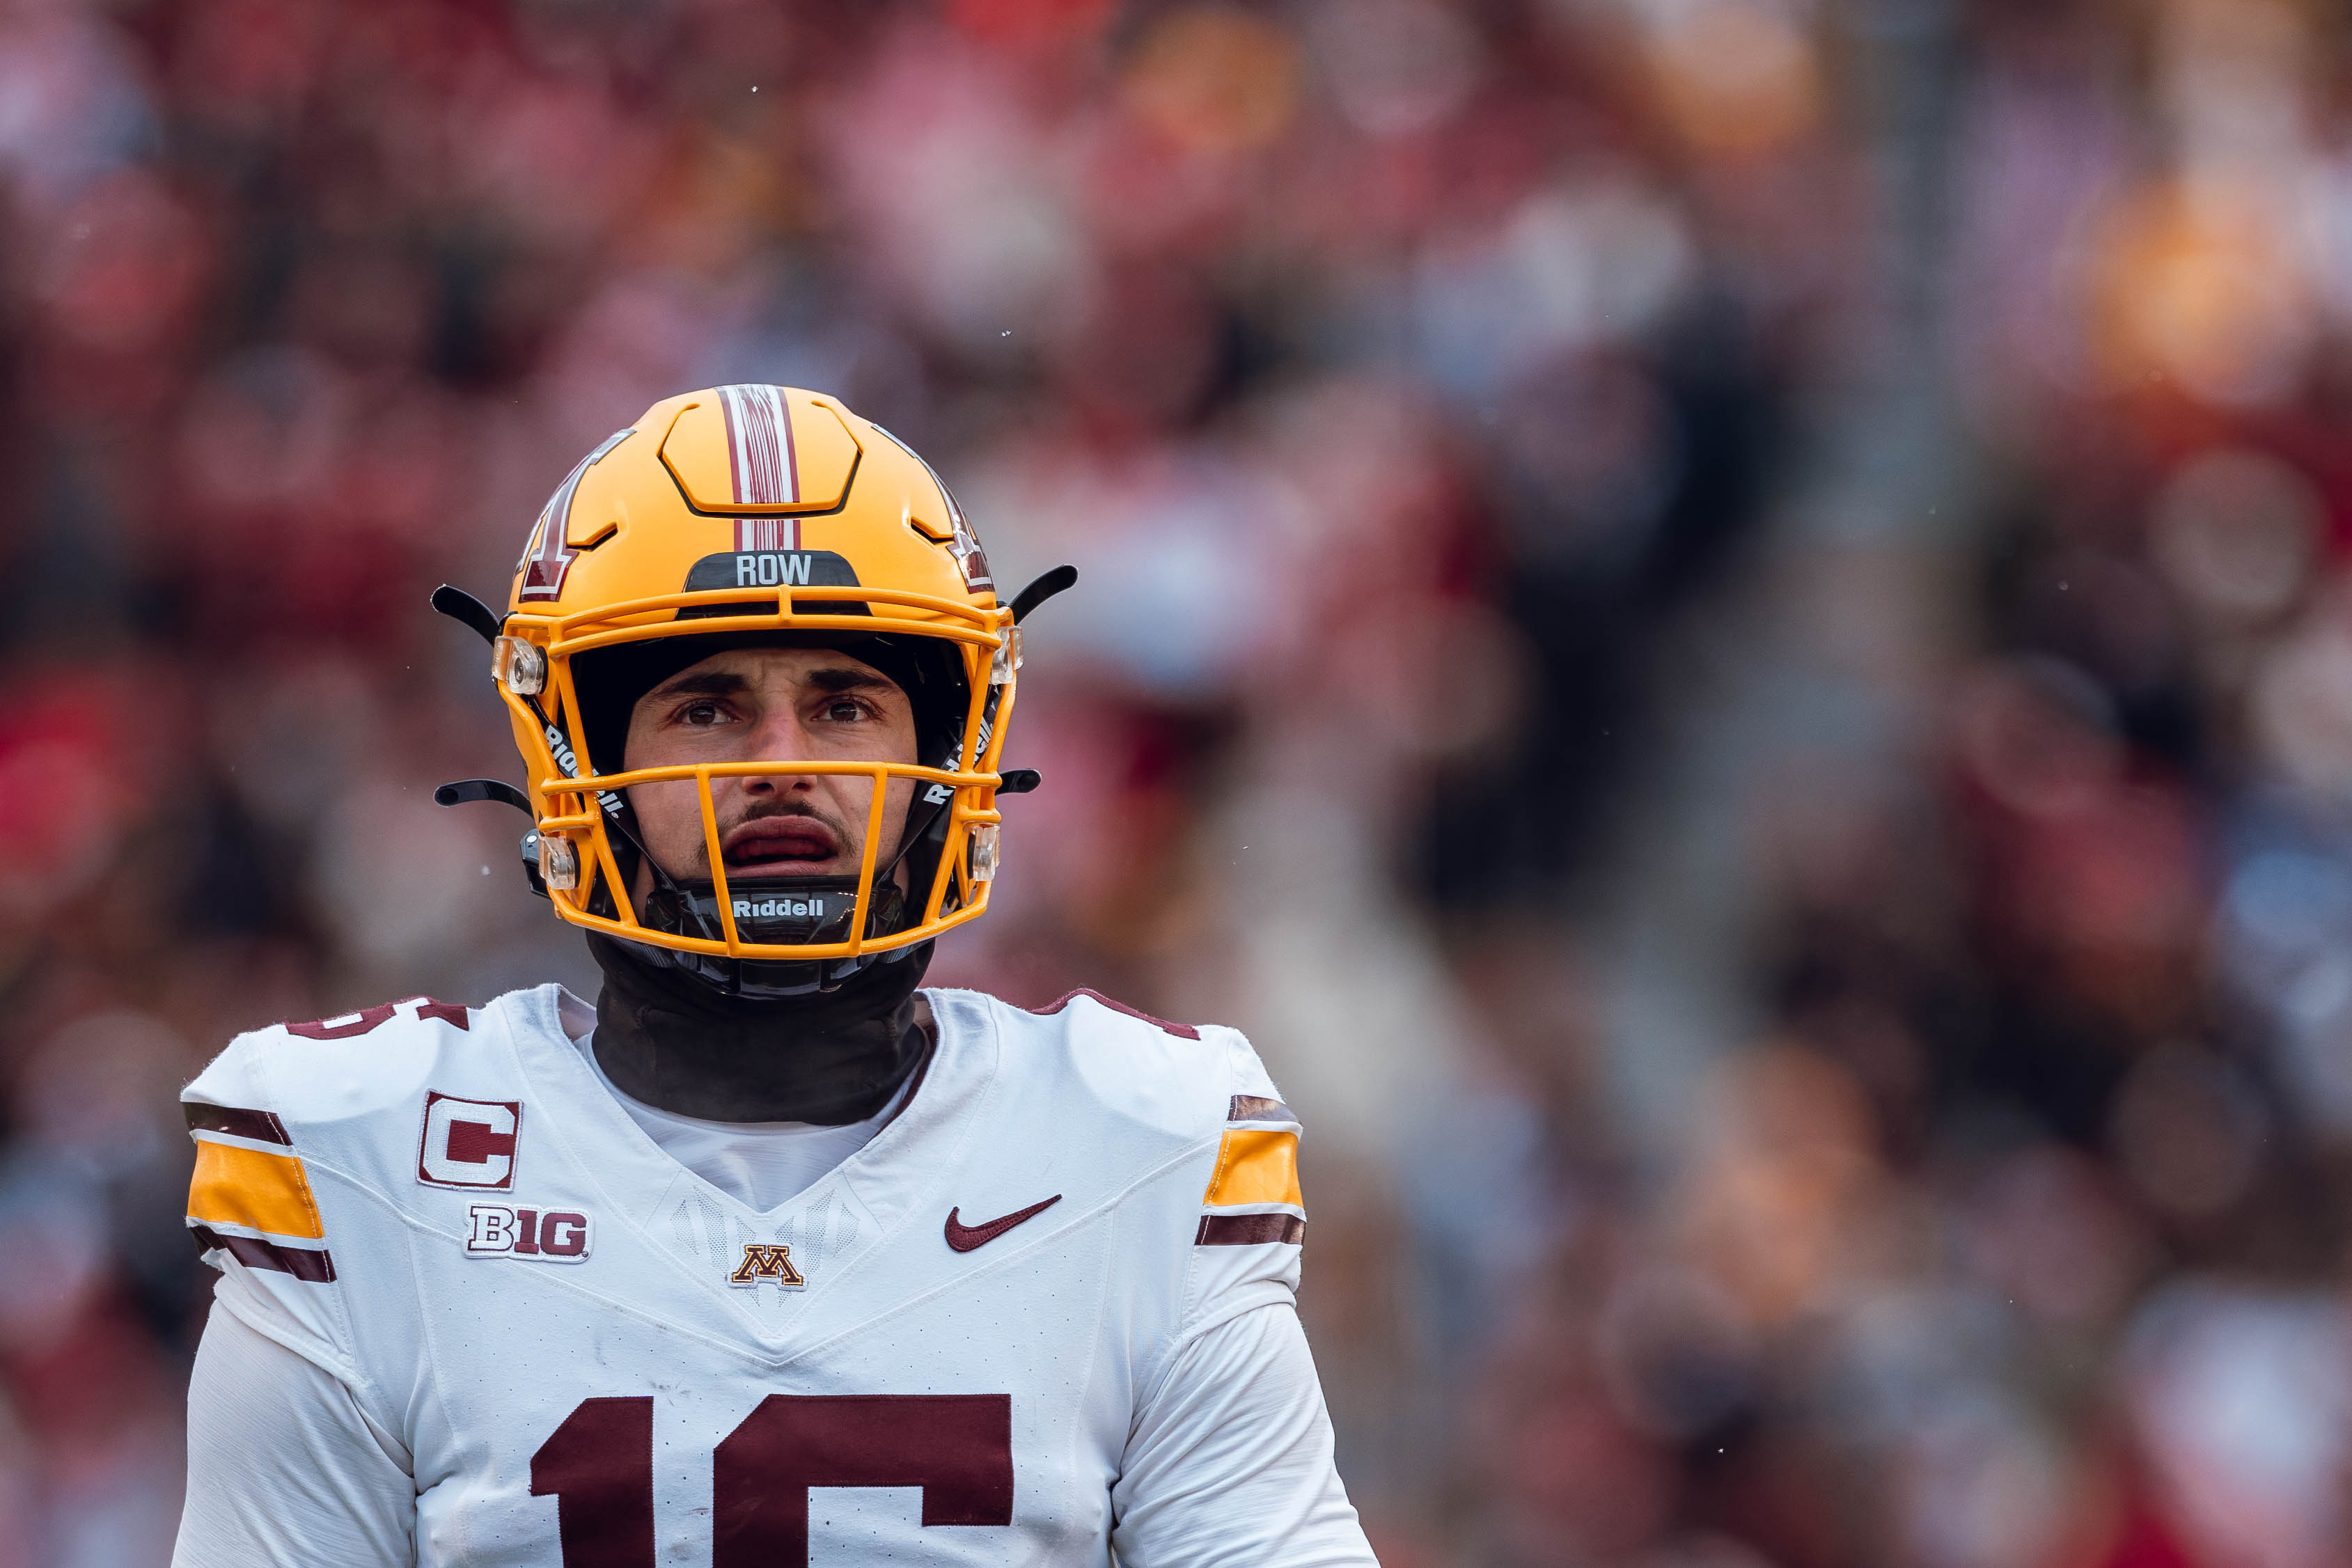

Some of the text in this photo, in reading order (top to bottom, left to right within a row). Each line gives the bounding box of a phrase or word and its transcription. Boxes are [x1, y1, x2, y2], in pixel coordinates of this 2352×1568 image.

[737, 554, 812, 586] ROW
[545, 724, 624, 813] Ridll
[733, 900, 823, 918] Riddell
[422, 1097, 516, 1185] C
[732, 1244, 803, 1286] M
